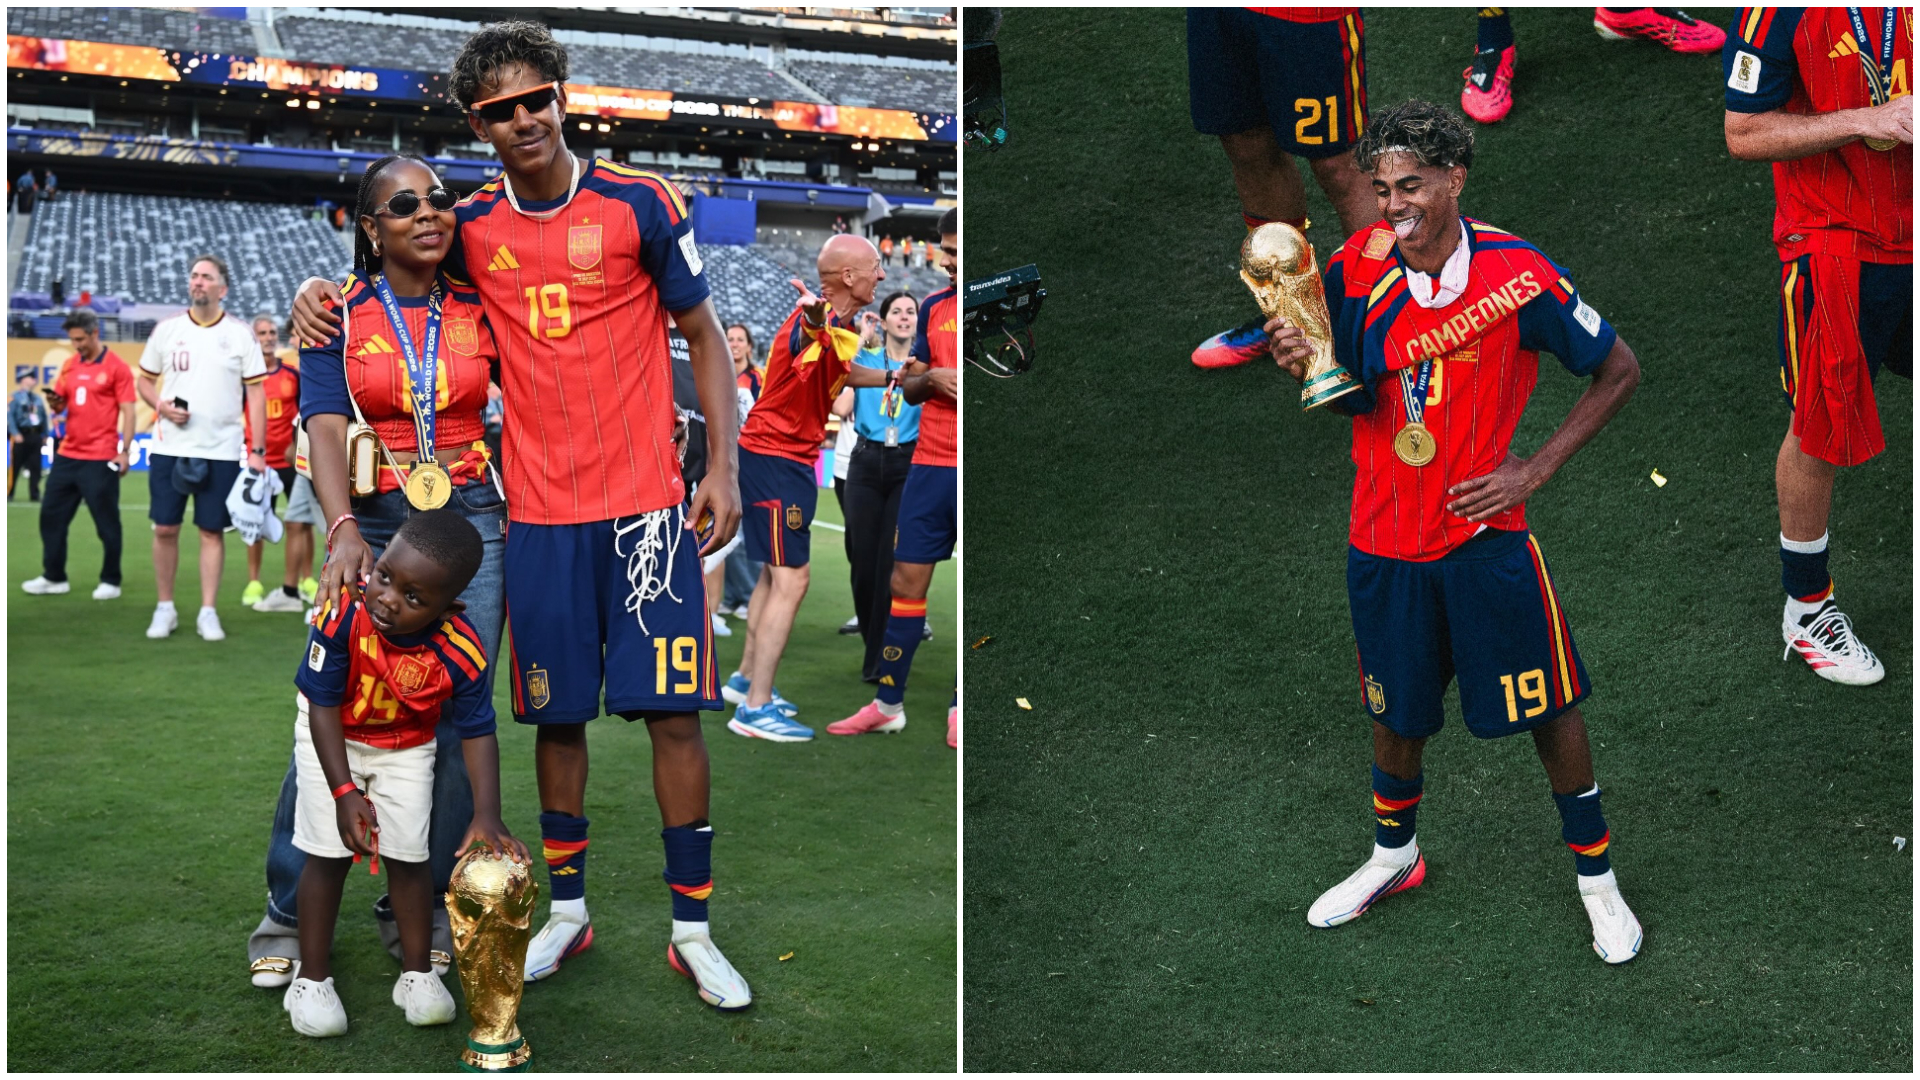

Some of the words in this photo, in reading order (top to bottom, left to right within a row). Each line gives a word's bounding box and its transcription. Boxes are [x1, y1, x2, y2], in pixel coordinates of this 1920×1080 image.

[1853, 15, 1866, 43] 2026
[1885, 11, 1894, 40] WORLD
[1883, 41, 1891, 58] FIFA
[230, 60, 379, 92] CHAMPIONS
[1294, 95, 1338, 145] 21
[525, 283, 571, 340] 19
[1405, 270, 1542, 364] CAMPEONES
[381, 288, 392, 305] FIFA
[388, 303, 404, 329] WORLD
[398, 329, 410, 344] CUP
[404, 344, 418, 373] 2026
[427, 326, 437, 352] 2026
[170, 350, 190, 373] 10
[425, 352, 434, 368] CUP
[75, 386, 87, 406] 8
[424, 369, 433, 401] WORLD
[1418, 373, 1428, 391] FIFA
[653, 636, 698, 695] 19
[1499, 668, 1548, 723] 19
